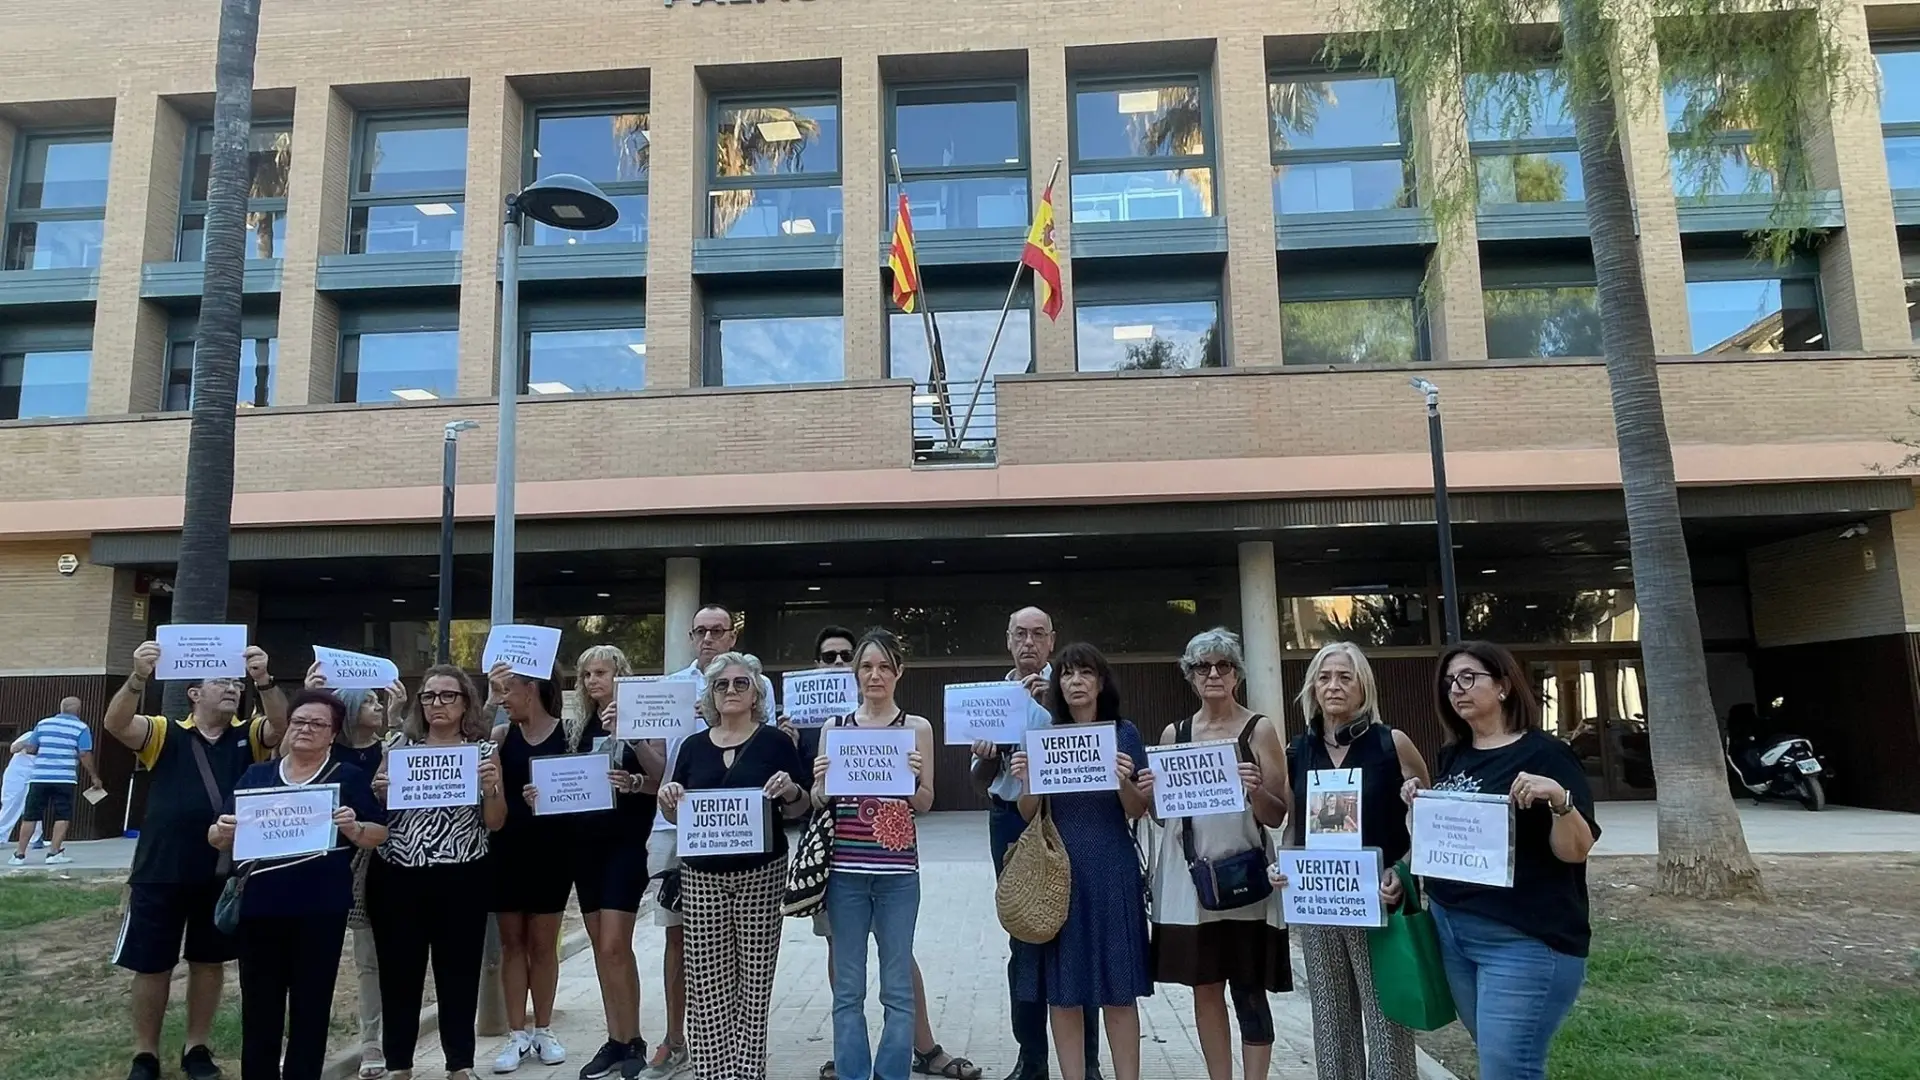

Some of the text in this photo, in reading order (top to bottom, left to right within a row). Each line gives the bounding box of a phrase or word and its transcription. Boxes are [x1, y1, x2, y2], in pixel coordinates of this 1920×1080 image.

[794, 678, 846, 692] VERITAT I
[795, 692, 846, 705] JUSTICIA
[961, 698, 1011, 707] BIENVENIDA
[970, 718, 1005, 728] SEÑORÍA
[1041, 734, 1100, 750] VERITAT I
[840, 745, 898, 756] BIENVENIDA
[1044, 749, 1101, 764] JUSTICIA
[407, 754, 463, 768] VERITAT I
[844, 759, 850, 768] A
[853, 758, 865, 768] SU
[1160, 752, 1224, 772] VERITAT I
[407, 768, 462, 781] JUSTICIA
[848, 770, 892, 781] SEÑORÍA
[1040, 768, 1052, 777] per
[1166, 768, 1227, 788] JUSTICIA
[1062, 776, 1081, 784] Dana
[1083, 775, 1107, 783] 29-oct
[443, 791, 466, 799] 29-oct
[550, 792, 591, 802] DIGNITAT
[1162, 793, 1176, 802] per
[1184, 790, 1197, 798] les
[692, 798, 748, 812] VERITAT I
[1166, 798, 1236, 811] de la Dana 29-oct
[255, 806, 313, 818] BIENVENIDA
[260, 821, 266, 829] A
[268, 820, 280, 828] SU
[693, 813, 748, 827] JUSTICIA
[263, 828, 305, 840] SEÑORÍA
[687, 832, 700, 840] per
[708, 830, 719, 838] les
[689, 839, 753, 849] de la Dana 29-oct
[1296, 859, 1360, 875] VERITAT I
[1298, 876, 1360, 892] JUSTICIA
[1293, 895, 1306, 904] per
[1315, 895, 1327, 904] les
[1296, 906, 1367, 916] de la Dana 29-oct
